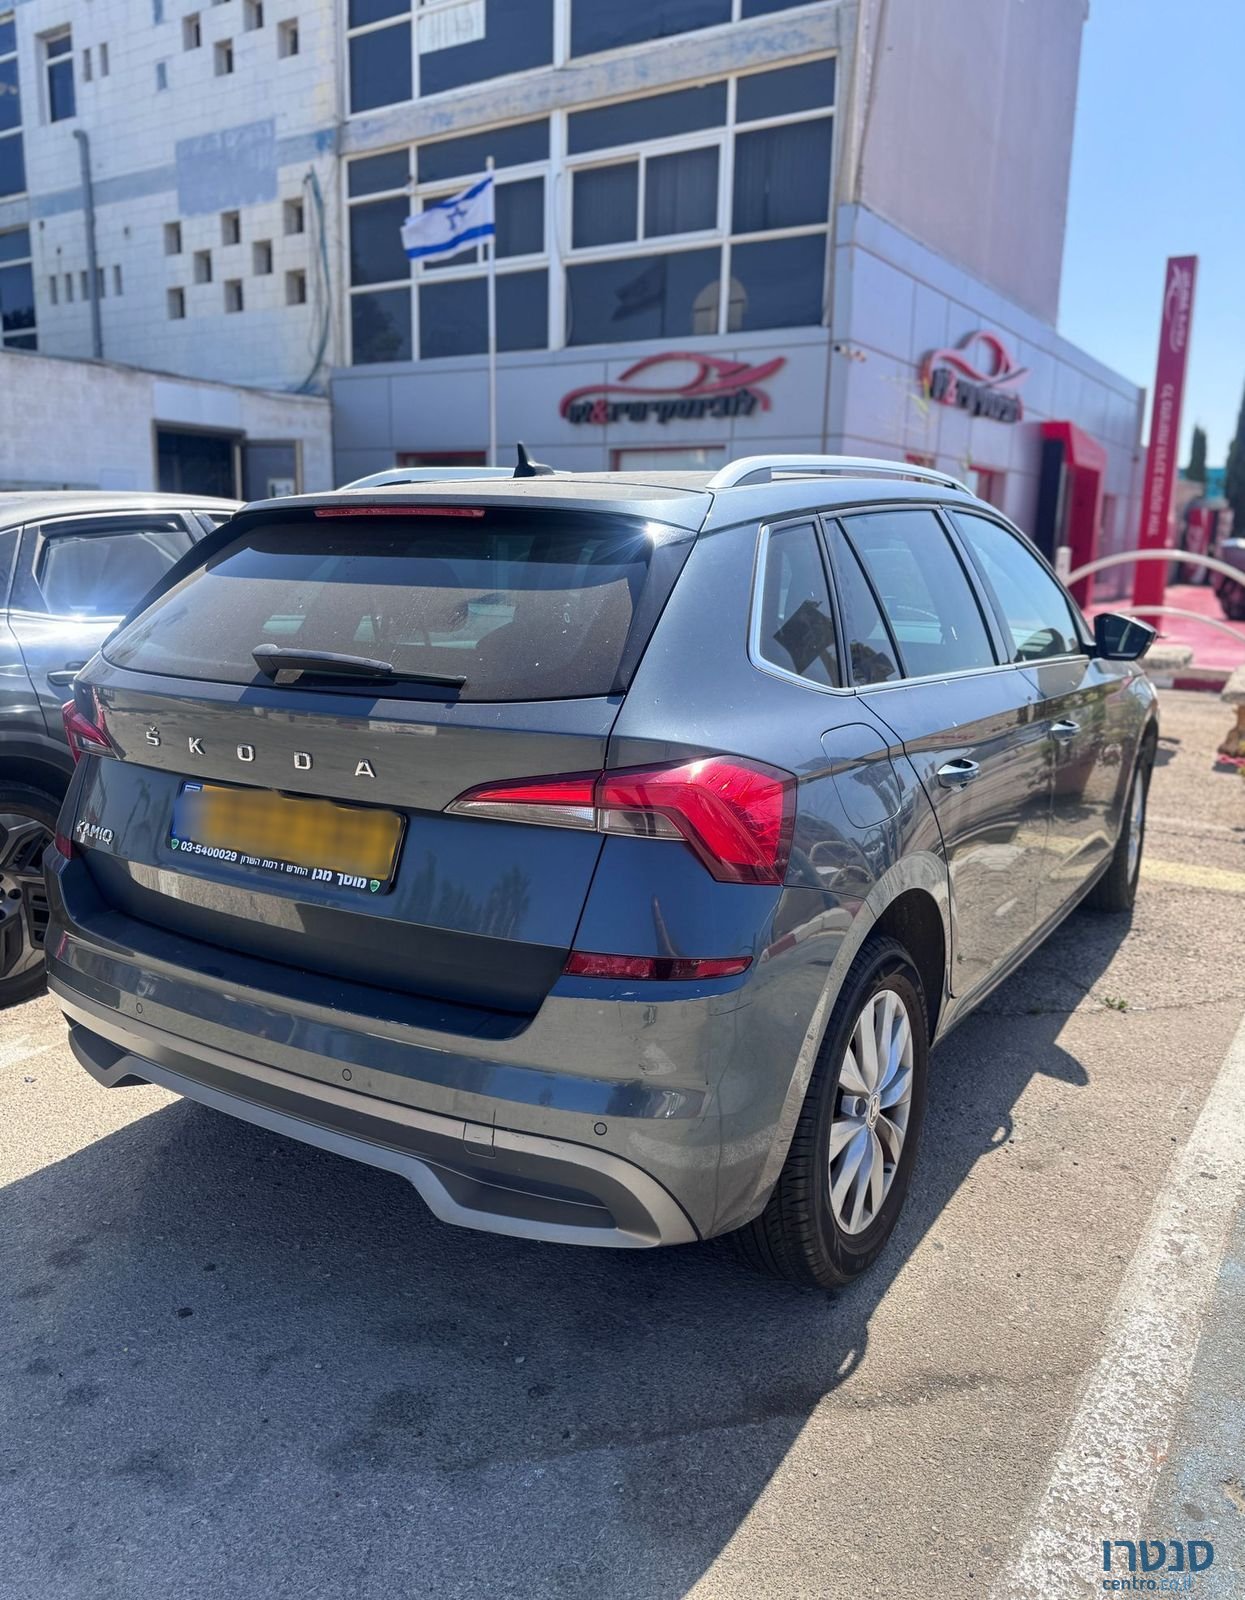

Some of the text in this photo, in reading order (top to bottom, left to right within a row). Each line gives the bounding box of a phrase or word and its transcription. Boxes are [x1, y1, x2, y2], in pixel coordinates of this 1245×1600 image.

[146, 726, 376, 779] ŠKODA
[76, 819, 114, 845] KAMIQ
[180, 841, 238, 862] 03-5400029
[240, 855, 261, 865] השרון
[261, 859, 278, 870] רמת
[311, 867, 333, 882] מגן
[337, 872, 367, 889] מוסך
